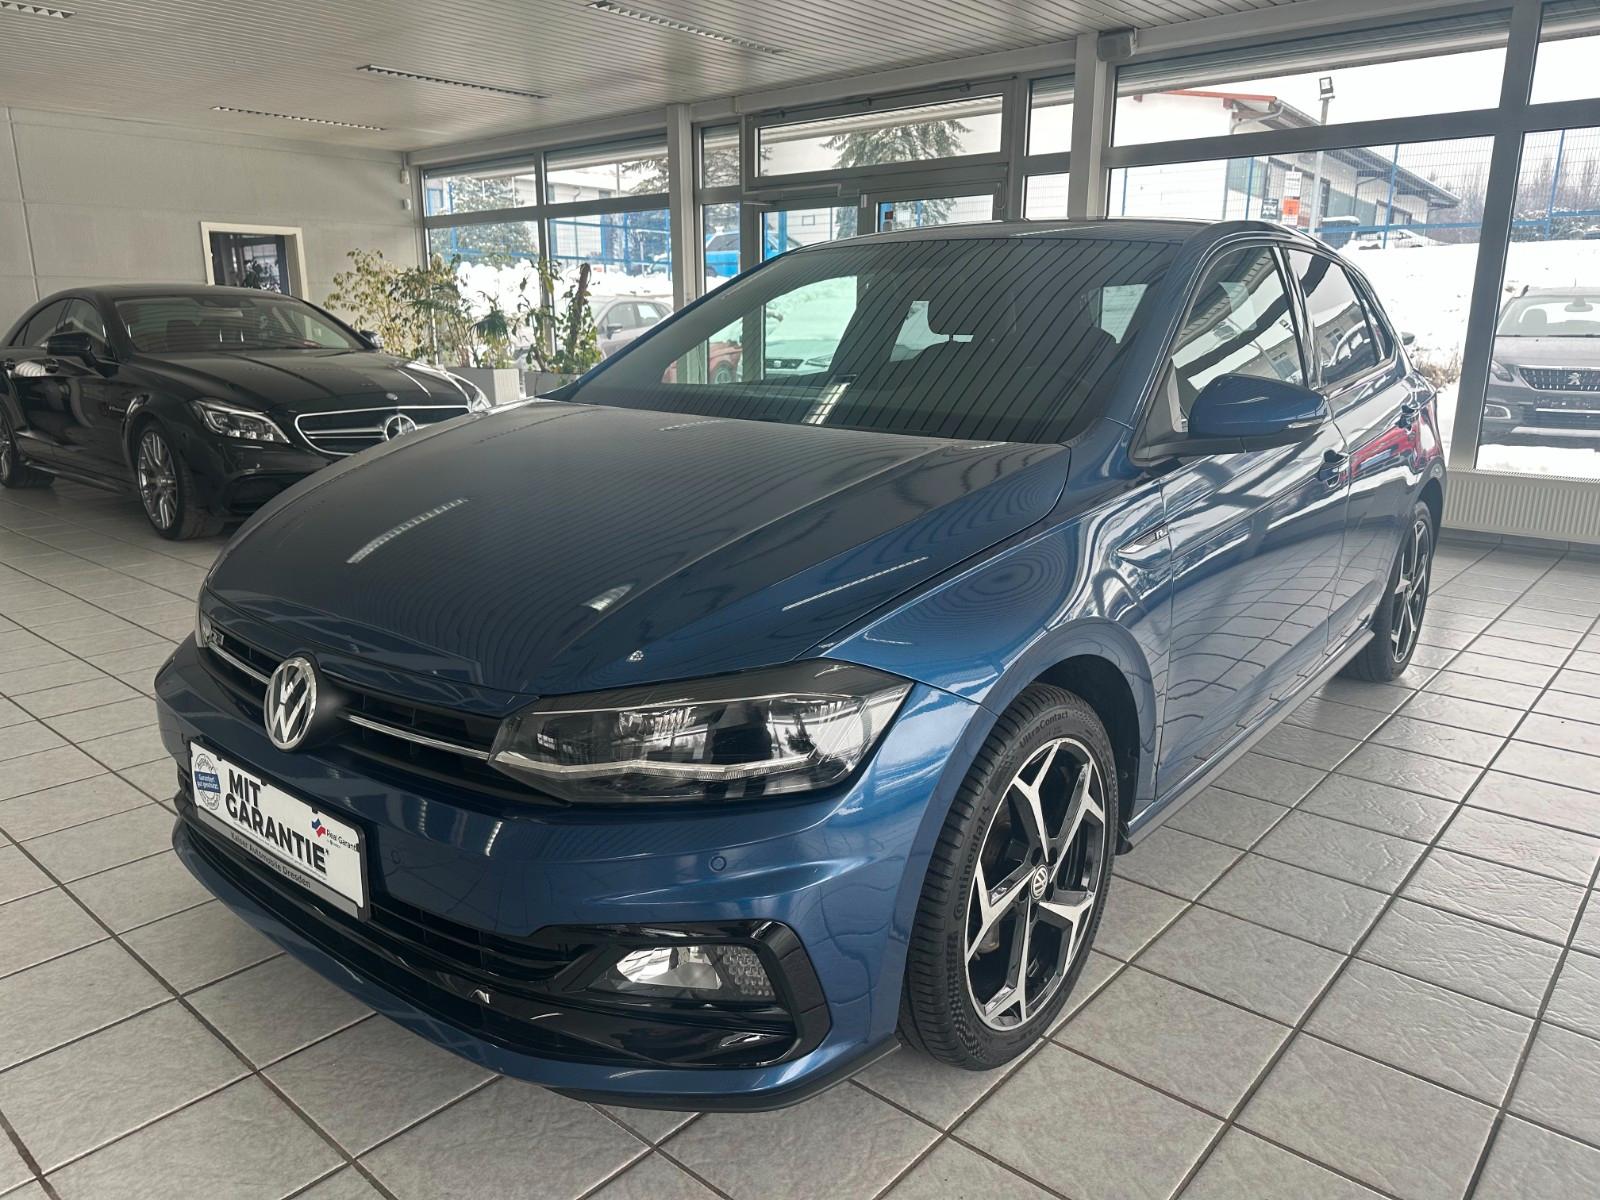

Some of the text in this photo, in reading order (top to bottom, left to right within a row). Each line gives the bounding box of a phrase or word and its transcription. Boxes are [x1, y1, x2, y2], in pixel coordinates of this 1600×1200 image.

[1019, 711, 1069, 748] UltraContact
[229, 768, 261, 808] MIT
[282, 866, 311, 889] Dresden
[953, 818, 986, 921] Continental
